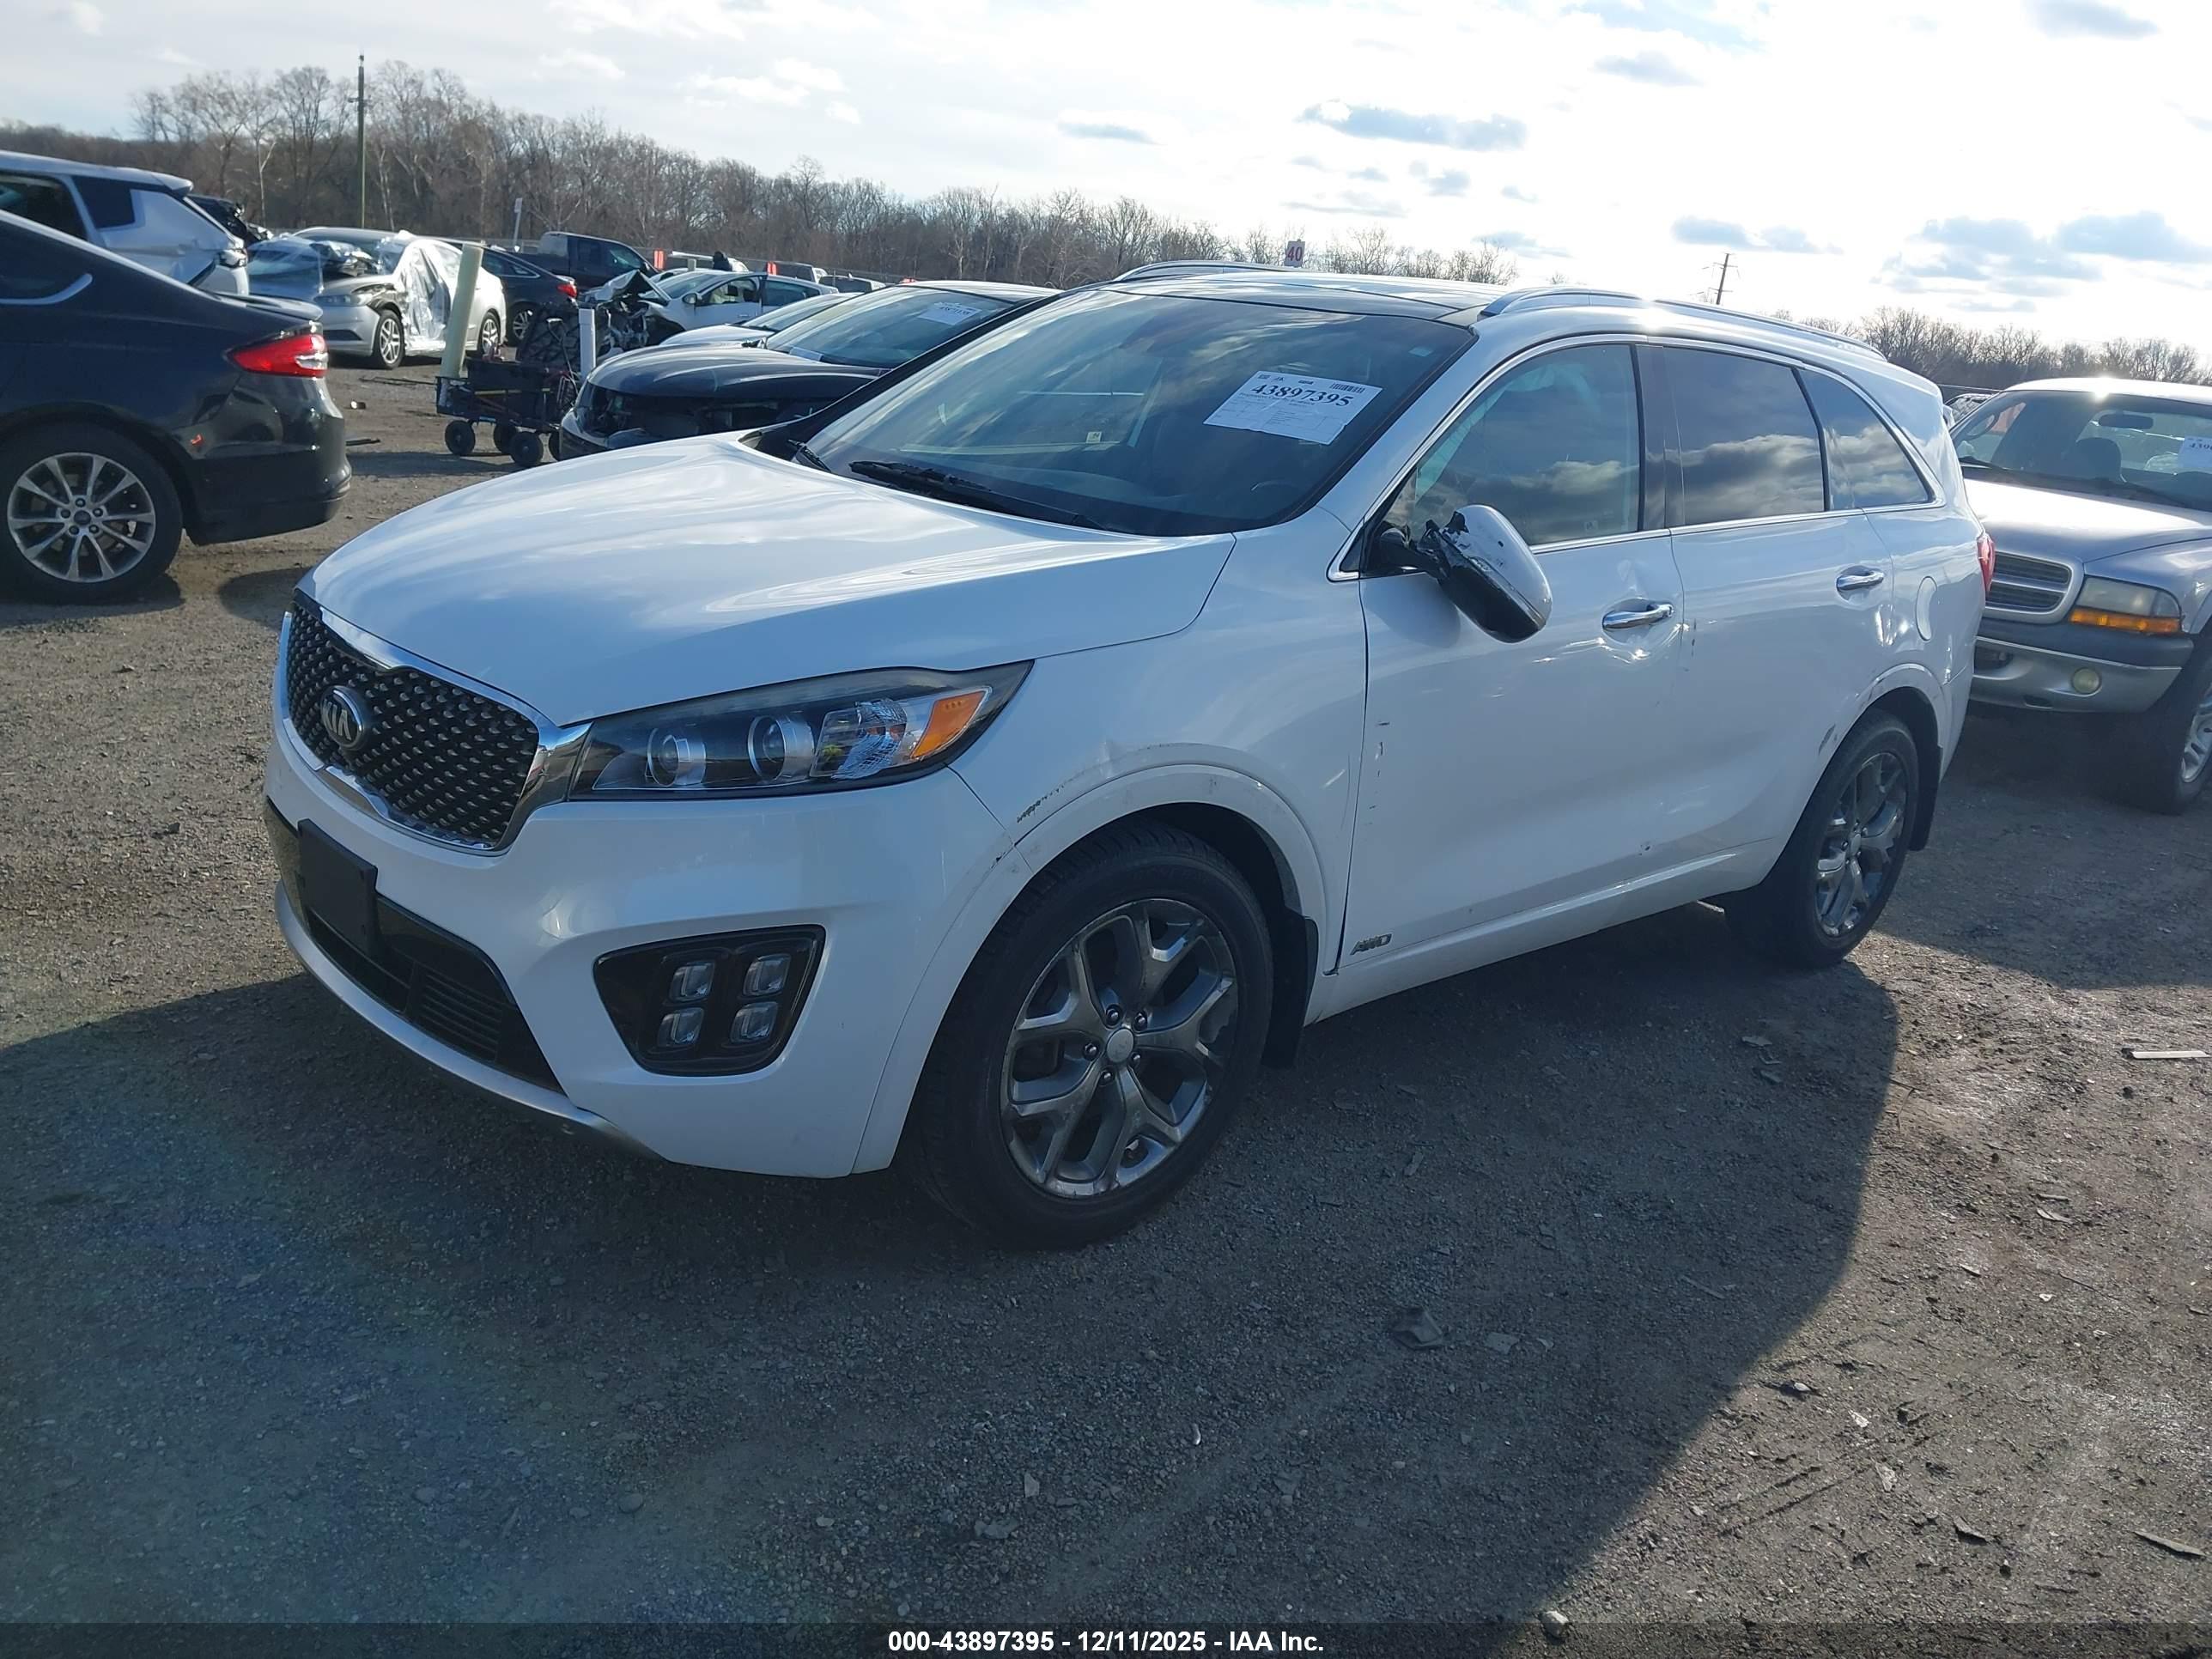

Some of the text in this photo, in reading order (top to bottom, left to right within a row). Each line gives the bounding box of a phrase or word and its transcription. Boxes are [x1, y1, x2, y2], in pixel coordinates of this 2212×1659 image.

[1287, 246, 1303, 262] 40
[1251, 384, 1355, 407] 43897395
[323, 697, 352, 741] KIA
[1349, 933, 1393, 956] AWD
